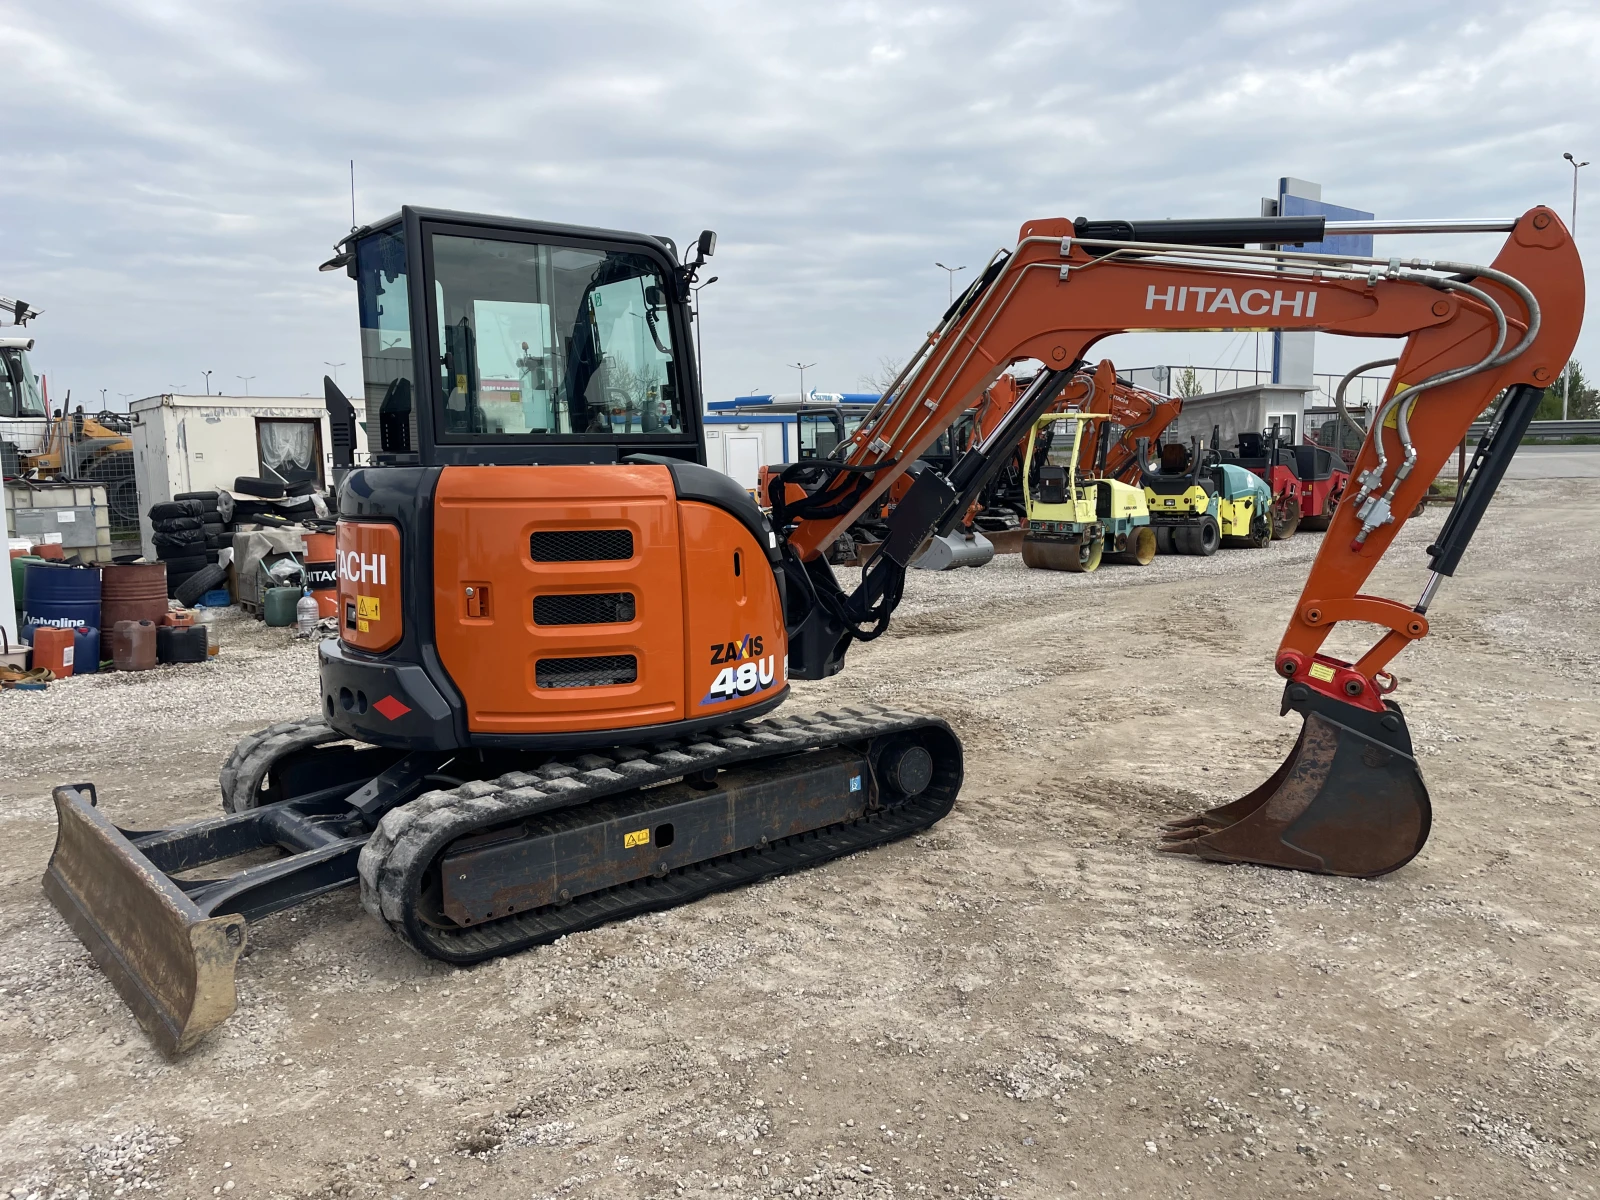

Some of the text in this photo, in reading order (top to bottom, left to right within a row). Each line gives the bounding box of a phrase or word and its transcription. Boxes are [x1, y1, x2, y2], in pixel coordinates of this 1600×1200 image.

[1145, 285, 1317, 317] HITACHI
[27, 616, 86, 628] Valvoline
[711, 634, 763, 665] ZAXIS
[711, 655, 774, 700] 48U
